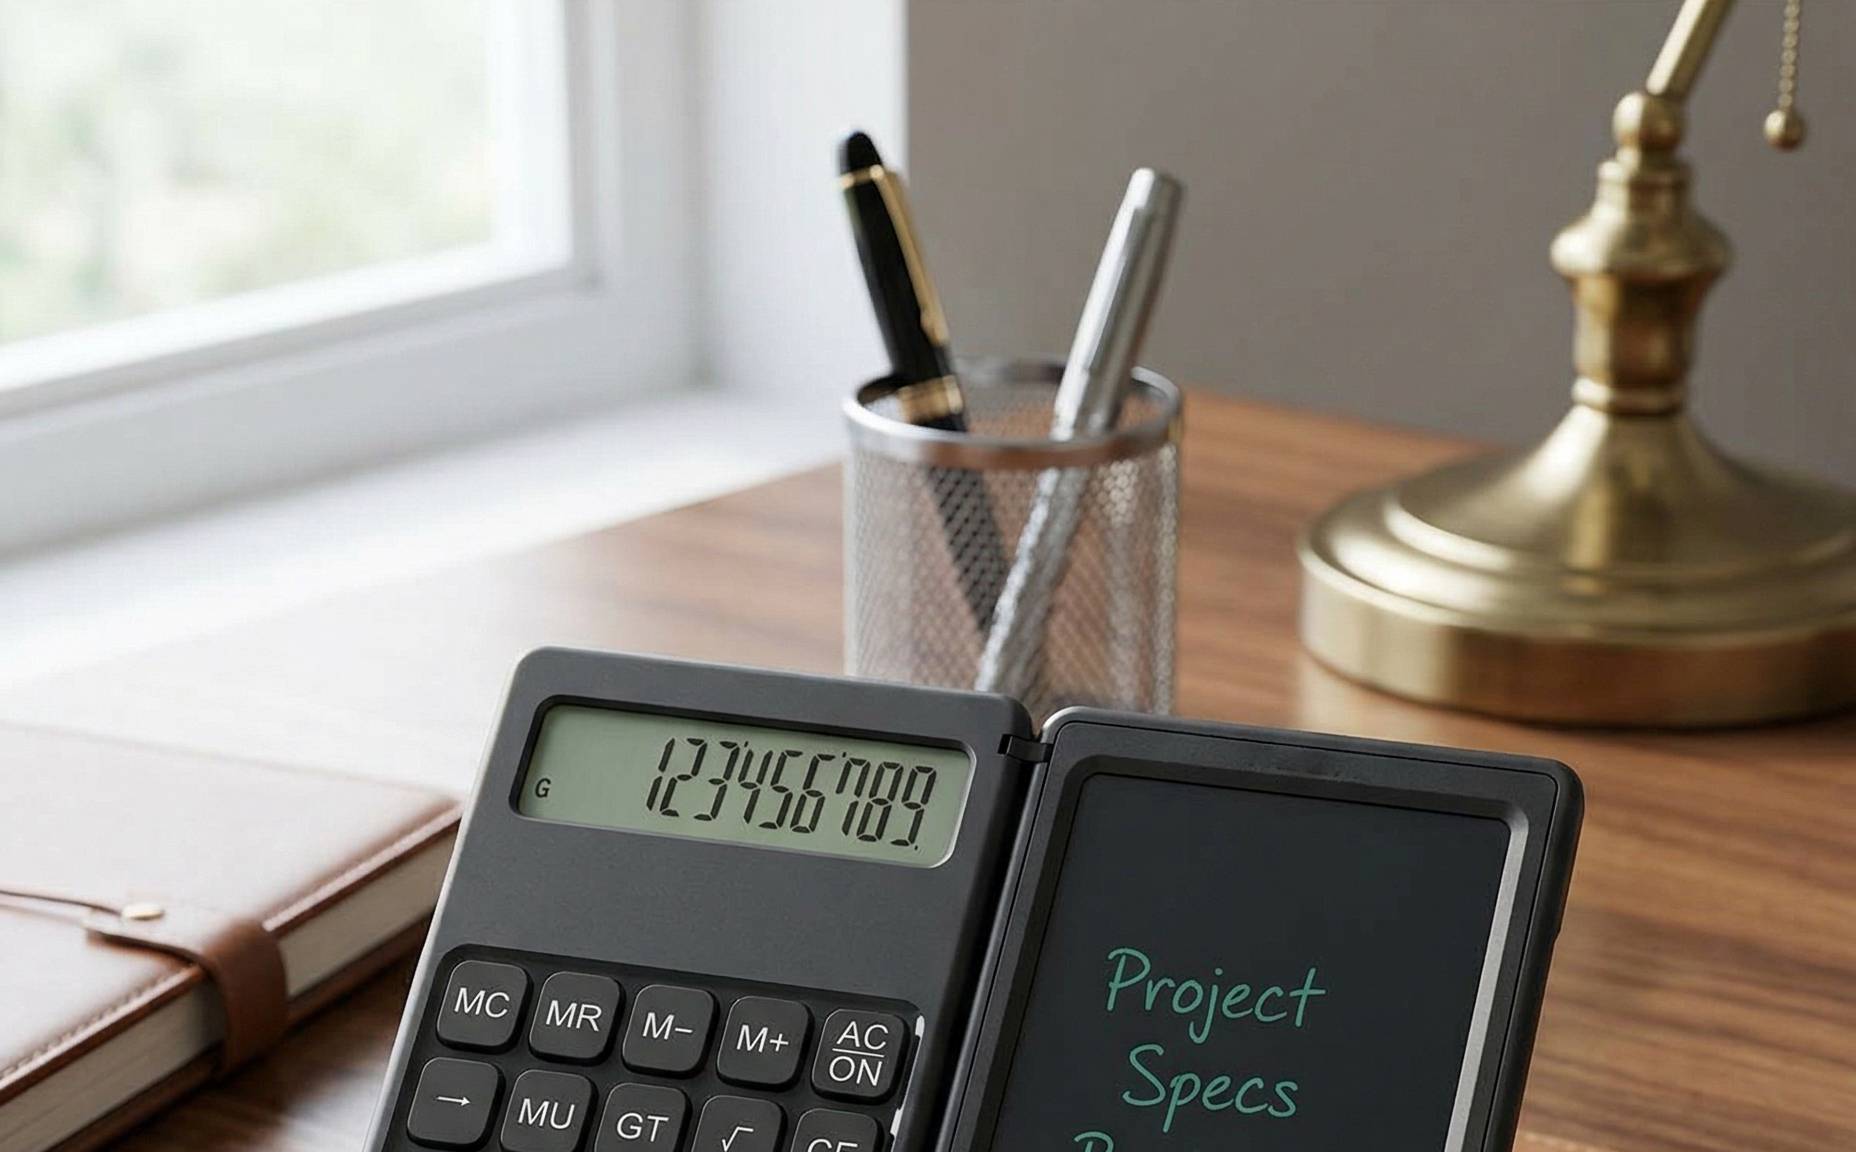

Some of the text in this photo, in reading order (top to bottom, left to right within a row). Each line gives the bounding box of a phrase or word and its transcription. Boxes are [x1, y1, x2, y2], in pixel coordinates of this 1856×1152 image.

[535, 778, 552, 799] G
[453, 986, 511, 1018] MC
[1106, 947, 1326, 1045] Project
[544, 1000, 602, 1032] MR
[735, 1024, 790, 1053] M+
[836, 1020, 889, 1050] AC
[829, 1056, 884, 1087] ON
[1122, 1043, 1298, 1133] Specs
[516, 1098, 576, 1130] MU
[615, 1112, 670, 1143] GT
